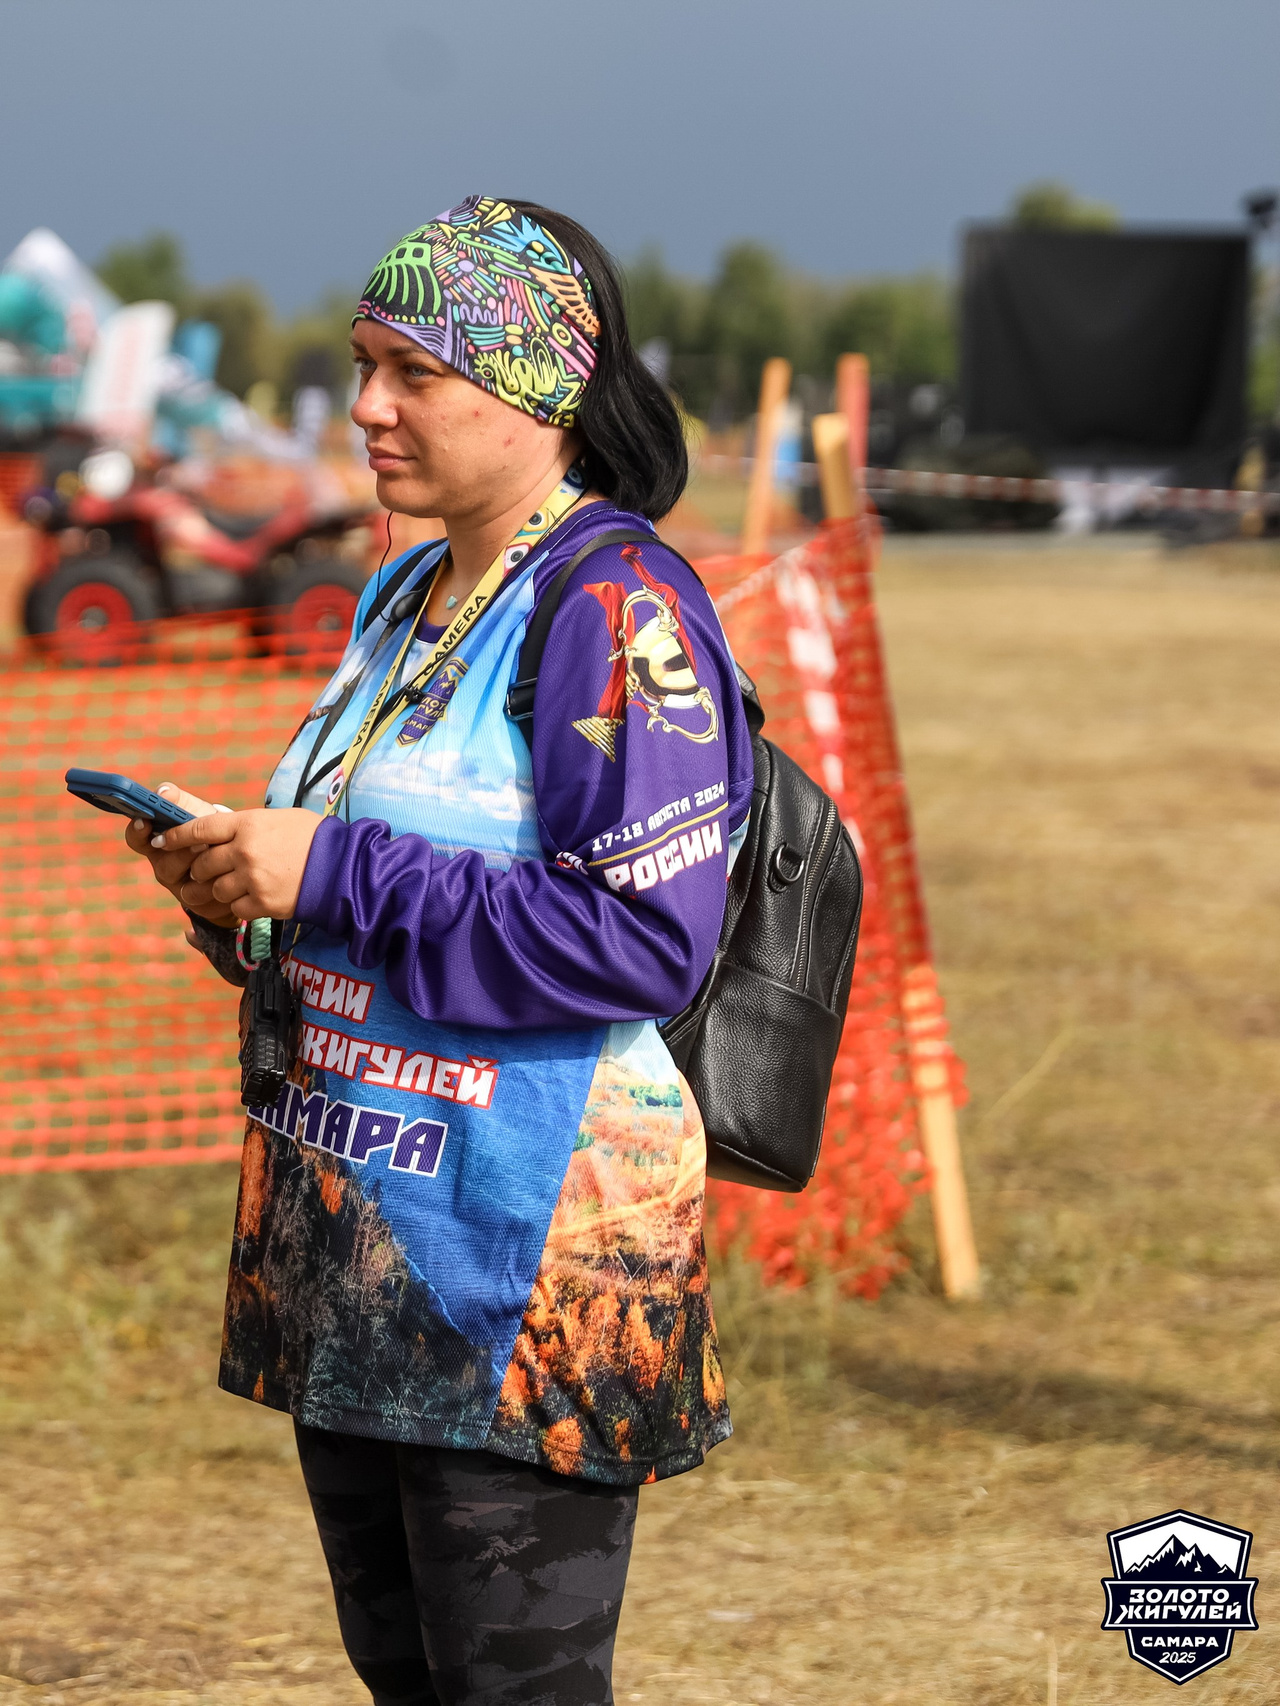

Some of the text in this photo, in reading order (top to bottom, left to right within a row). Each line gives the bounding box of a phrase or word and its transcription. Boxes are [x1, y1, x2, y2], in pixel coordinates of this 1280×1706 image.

[423, 595, 488, 676] CAMERA
[353, 665, 396, 747] CAMERA
[421, 696, 447, 710] ЛОТ
[591, 820, 644, 852] 17-18
[694, 780, 726, 808] 2024
[280, 953, 374, 1023] ОССИИ
[298, 1024, 497, 1108] ЖИГУЛЕЙ
[247, 1080, 449, 1178] АМАРА
